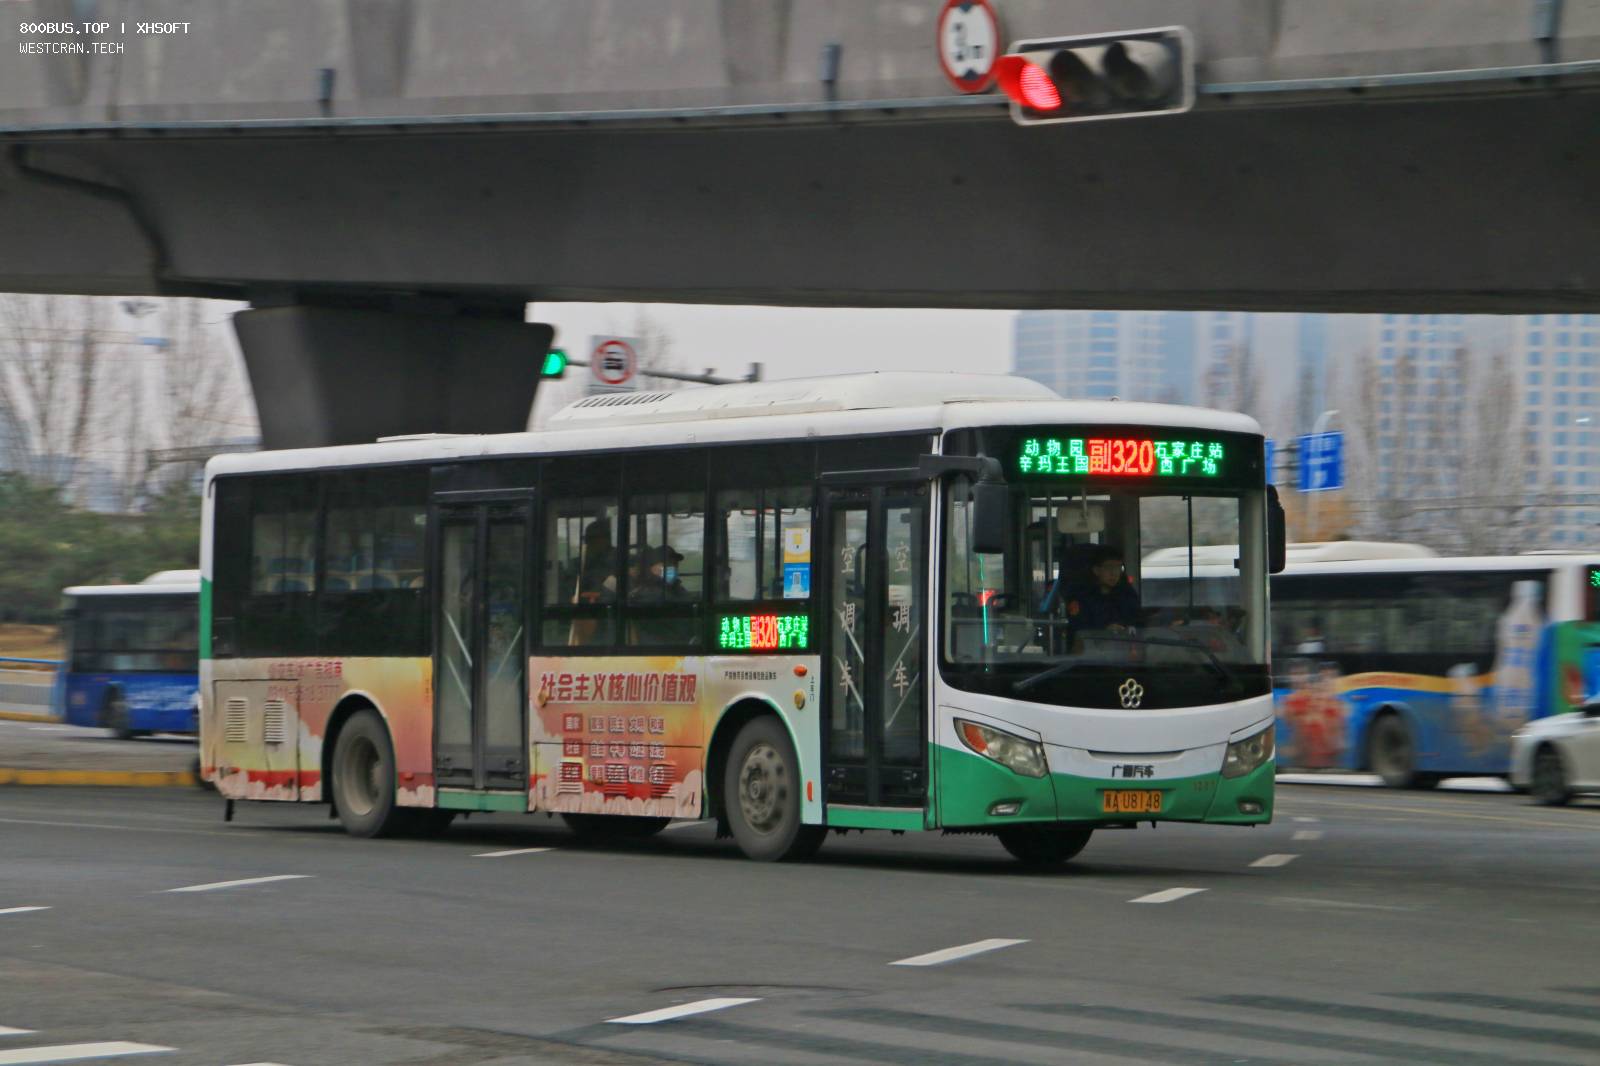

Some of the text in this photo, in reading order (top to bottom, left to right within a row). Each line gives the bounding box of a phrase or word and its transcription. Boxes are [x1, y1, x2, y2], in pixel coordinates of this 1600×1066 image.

[1025, 439, 1085, 457] 动物园
[1089, 440, 1154, 473] 副320
[1154, 442, 1223, 459] 石家庄站
[1019, 455, 1089, 473] 辛玛王国
[1160, 457, 1217, 474] 西广场
[839, 544, 856, 696] 空调车
[892, 542, 910, 697] 空调车
[541, 673, 697, 703] 社会主义核心价值观
